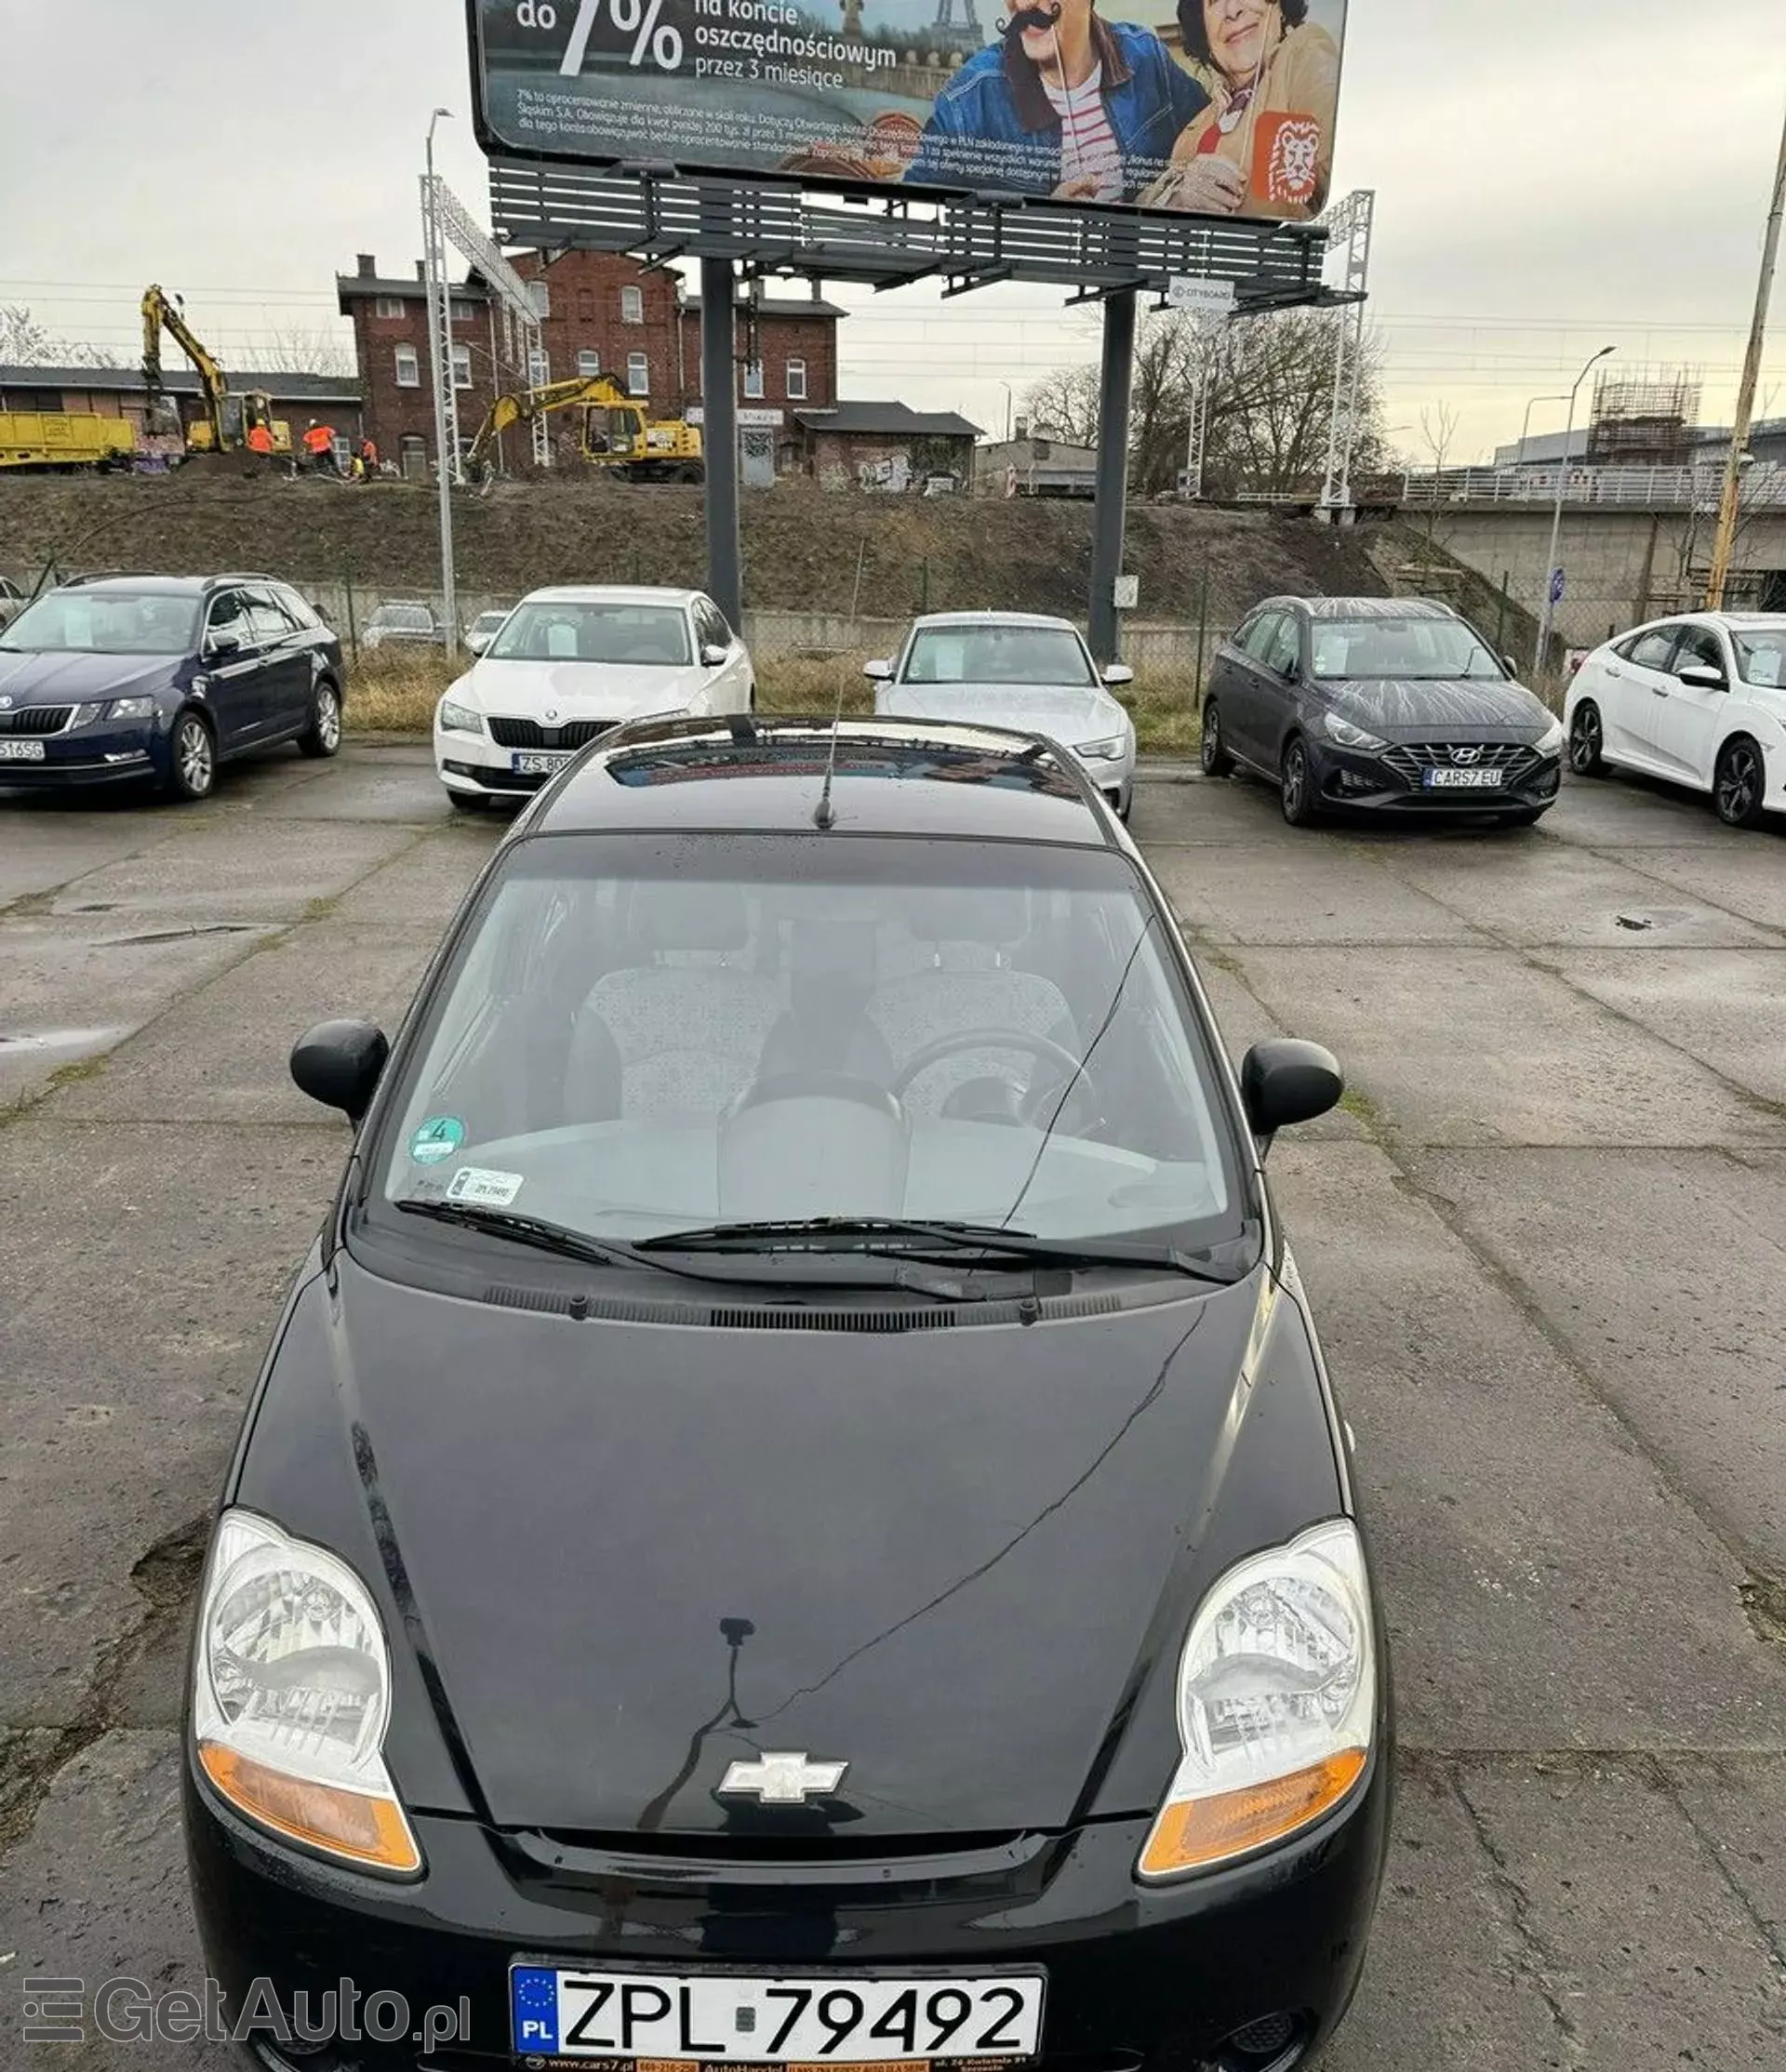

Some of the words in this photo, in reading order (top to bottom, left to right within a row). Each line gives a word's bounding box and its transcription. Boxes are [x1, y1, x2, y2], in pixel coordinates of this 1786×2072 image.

[517, 0, 556, 29] do
[695, 0, 721, 16] na
[729, 0, 797, 25] koncie
[695, 26, 896, 72] oszczędnościowym
[696, 57, 743, 77] przez
[749, 59, 759, 79] 3
[766, 63, 843, 90] miesiące
[432, 1120, 446, 1140] 4
[522, 2020, 553, 2039] PL
[564, 1980, 726, 2052] ZPL
[766, 1986, 1024, 2054] 79492
[548, 2059, 634, 2072] www.cars7.pl
